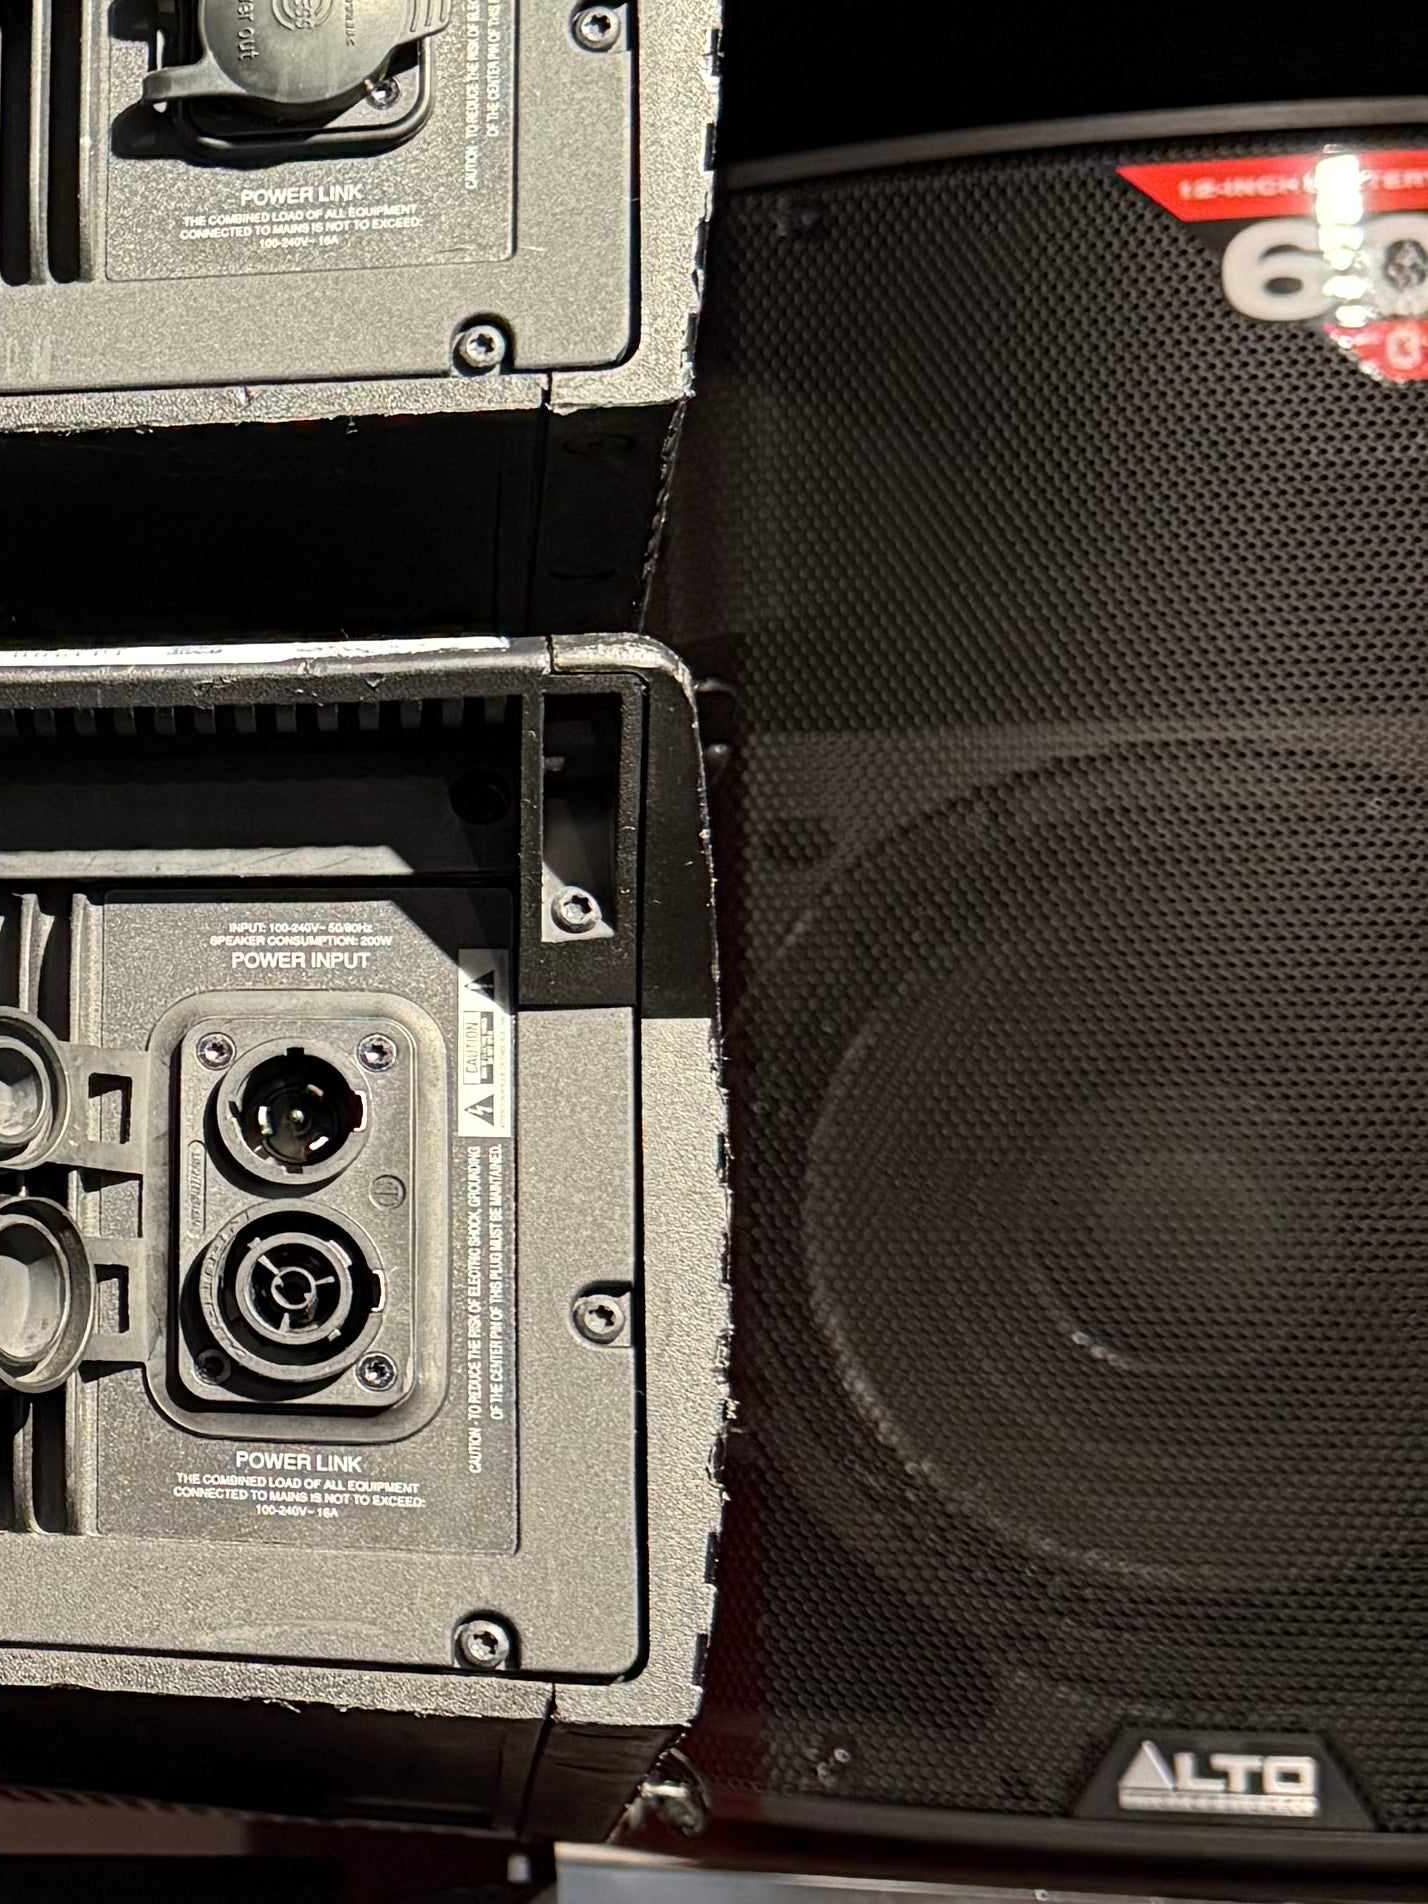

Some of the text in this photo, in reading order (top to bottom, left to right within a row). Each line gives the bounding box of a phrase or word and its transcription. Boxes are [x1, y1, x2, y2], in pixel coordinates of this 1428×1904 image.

[488, 4, 500, 26] THIS
[467, 23, 480, 36] OF
[488, 28, 500, 42] OF
[238, 29, 259, 61] out
[467, 38, 480, 60] RISK
[488, 43, 500, 60] PIN
[467, 62, 479, 81] THE
[487, 62, 500, 100] CENTER
[466, 83, 479, 123] REDUCE
[486, 102, 499, 122] THE
[466, 126, 479, 138] TO
[486, 123, 498, 136] OF
[465, 146, 478, 189] CAUTION
[240, 184, 363, 206] POWER LINK
[183, 203, 417, 227] THE COMBINED LOAD OF ALL EQUIPMENT
[179, 216, 423, 240] CONNECTED TO MAINS IS NOT TO EXCEED:
[228, 922, 266, 933] INPUT:
[209, 935, 393, 946] SPEAKER CONSUMPTION: 200W
[231, 951, 372, 969] POWER INPUT
[465, 1022, 478, 1074] CAUTION
[468, 1146, 480, 1208] GROUNDING
[488, 1144, 502, 1206] MAINTAINED.
[489, 1207, 502, 1222] BE
[468, 1208, 482, 1246] SHOCK,
[489, 1223, 502, 1251] MUST
[468, 1248, 480, 1296] ELECTRIC
[490, 1253, 502, 1280] PLUG
[490, 1281, 502, 1304] THIS
[468, 1298, 481, 1313] OF
[490, 1306, 503, 1320] OF
[468, 1316, 481, 1336] RISK
[490, 1321, 503, 1339] PIN
[468, 1340, 481, 1360] THE
[490, 1341, 503, 1382] CENTER
[468, 1362, 481, 1404] REDUCE
[490, 1384, 503, 1402] THE
[468, 1405, 481, 1420] TO
[490, 1405, 503, 1420] OF
[235, 1451, 363, 1473] POWER LINK
[467, 1428, 481, 1474] CAUTION
[176, 1472, 420, 1494] THE COMBINED LOAD OF ALL EQUIPMENT
[173, 1485, 426, 1508] CONNECTED TO MAINS IS NOT TO EXCEED:
[317, 1506, 339, 1518] 16A
[1117, 1740, 1317, 1795] ALTO
